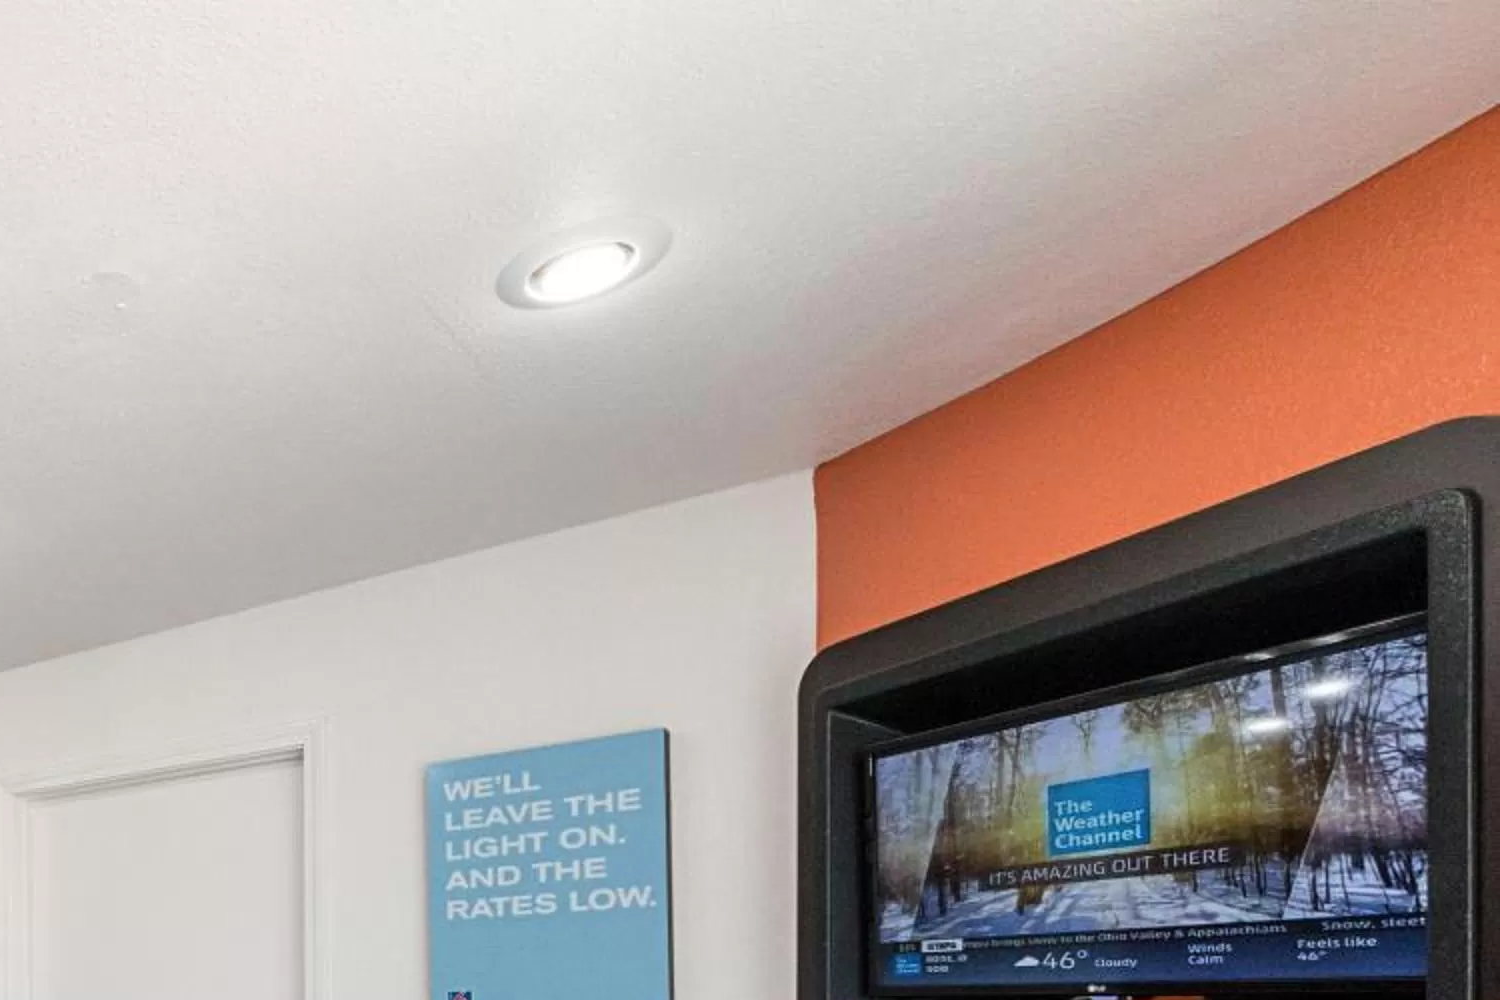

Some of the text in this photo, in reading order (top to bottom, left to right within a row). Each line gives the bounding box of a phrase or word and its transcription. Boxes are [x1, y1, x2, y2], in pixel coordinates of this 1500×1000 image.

[443, 771, 541, 801] WE'LL
[444, 788, 642, 832] LEAVE THE
[1054, 799, 1093, 817] The
[1054, 808, 1145, 832] Weather
[445, 824, 626, 862] LIGHT ON.
[1054, 826, 1144, 849] Channel
[445, 857, 607, 891] AND THE
[989, 847, 1230, 885] IT'S AMAZING OUT THERE
[446, 885, 657, 920] RATES LOW.
[1188, 942, 1232, 954] Winds
[1297, 935, 1378, 950] Feels like
[1188, 953, 1224, 965] Calm
